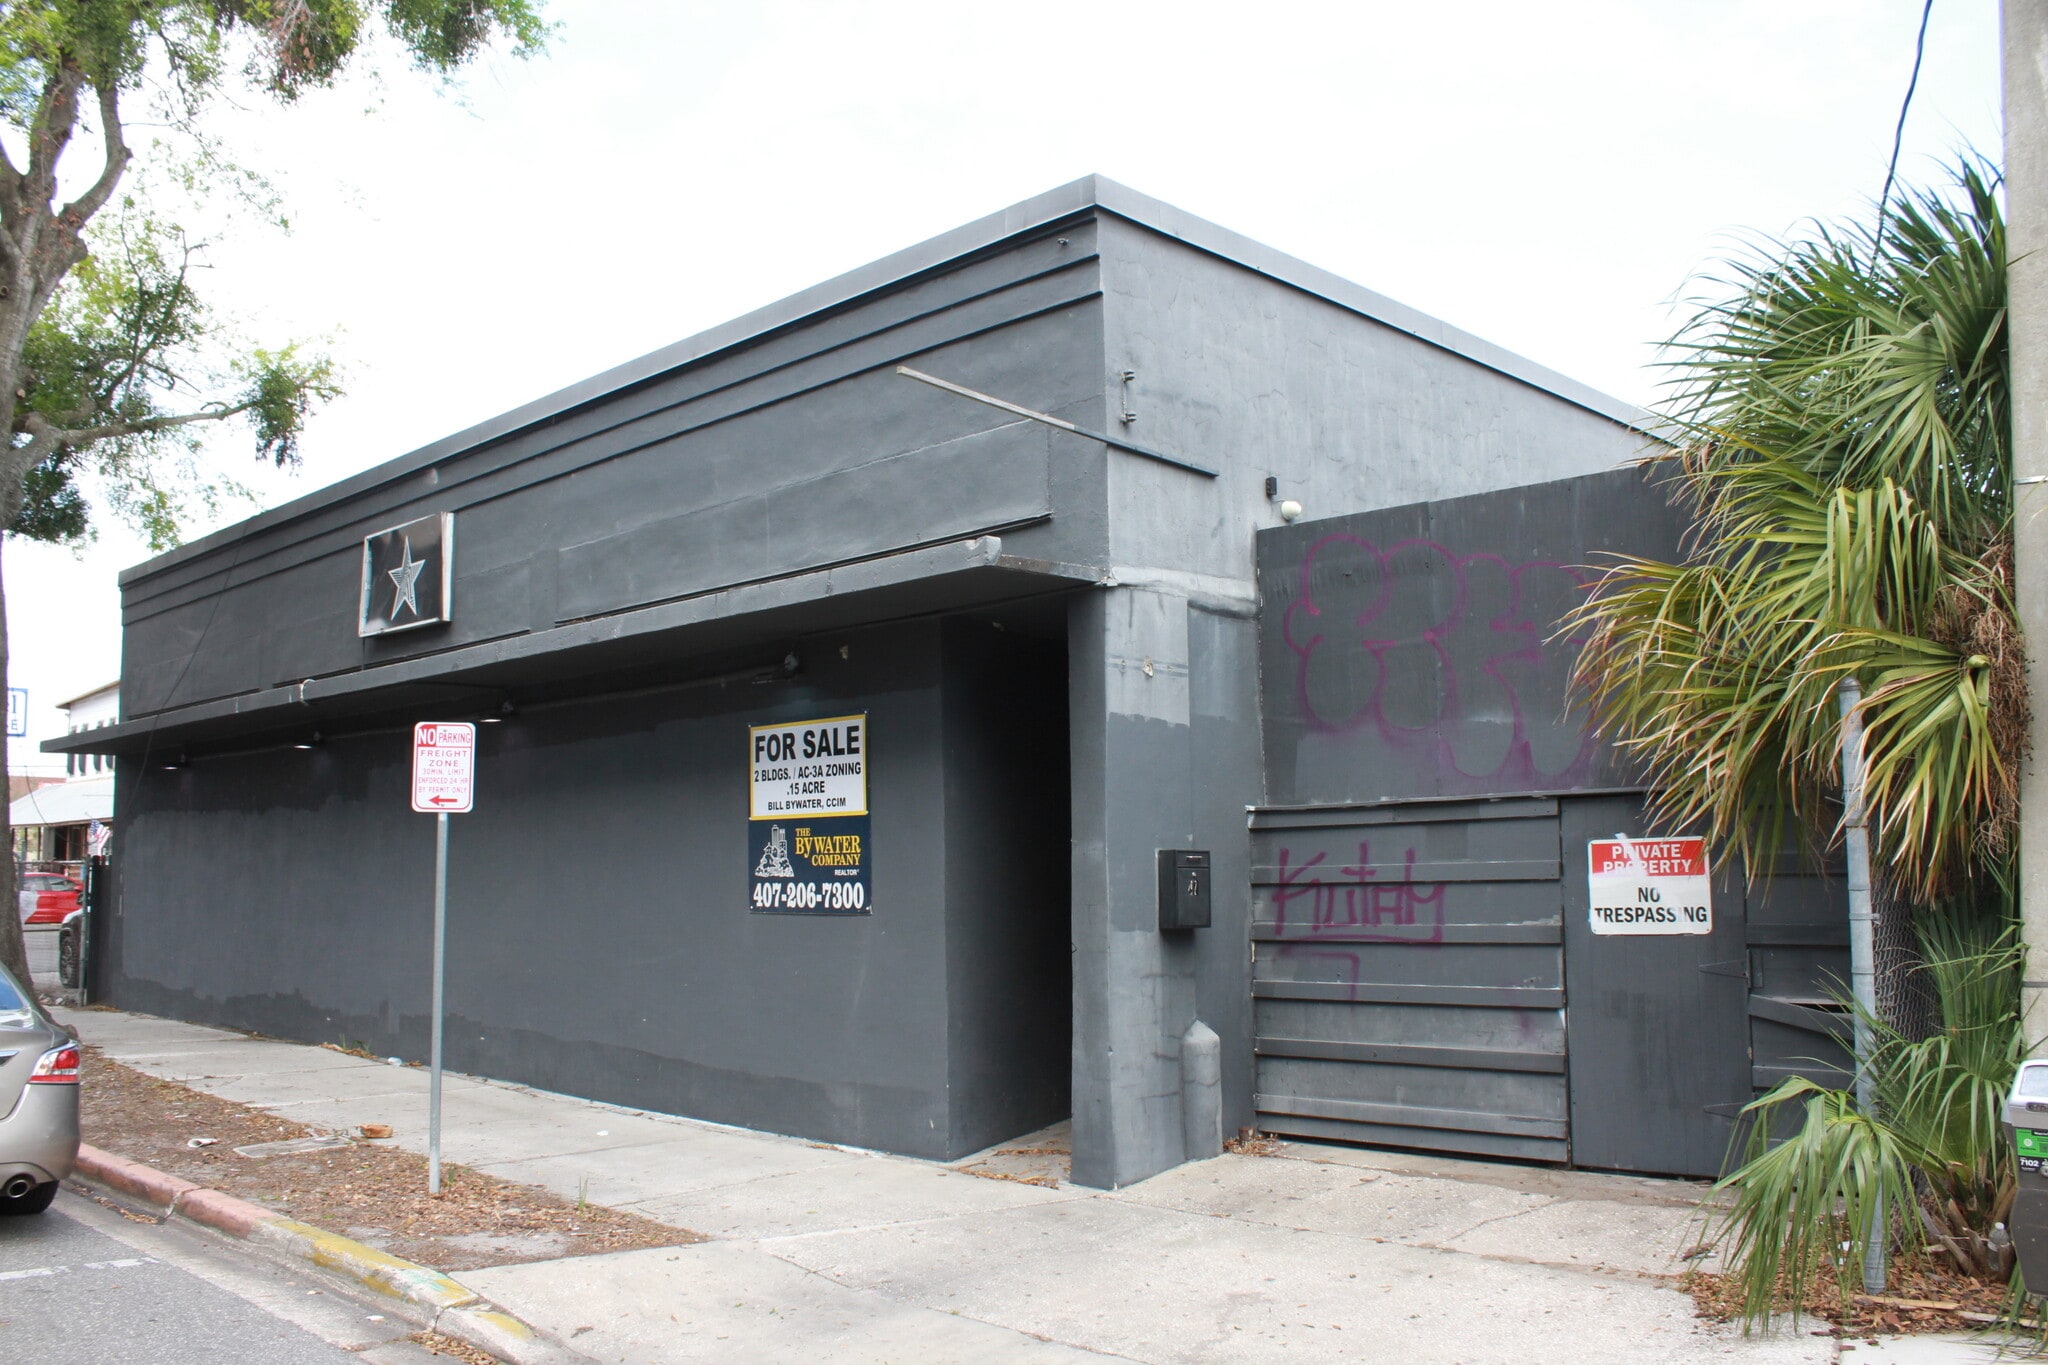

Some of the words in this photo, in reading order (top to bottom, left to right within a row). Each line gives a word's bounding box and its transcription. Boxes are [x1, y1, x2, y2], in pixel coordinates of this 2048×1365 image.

[418, 728, 436, 745] NO
[438, 732, 471, 743] PARKING
[755, 732, 796, 763] FOR
[803, 725, 860, 759] SALE
[429, 759, 459, 767] ZONE
[754, 770, 759, 782] 2
[761, 767, 791, 782] BLDGS.
[798, 765, 824, 779] AC-3A
[825, 761, 861, 777] ZONING
[787, 783, 799, 796] .15
[802, 781, 825, 795] ACRE
[768, 801, 783, 811] BILL
[785, 799, 824, 810] BYWATER,
[826, 797, 846, 807] CCIM
[795, 827, 811, 837] THE
[795, 835, 861, 858] BYWATER
[811, 854, 861, 866] COMPANY
[753, 881, 864, 909] 407-206-7300
[1638, 887, 1660, 903] NO
[1594, 906, 1707, 923] TRESPASSNG
